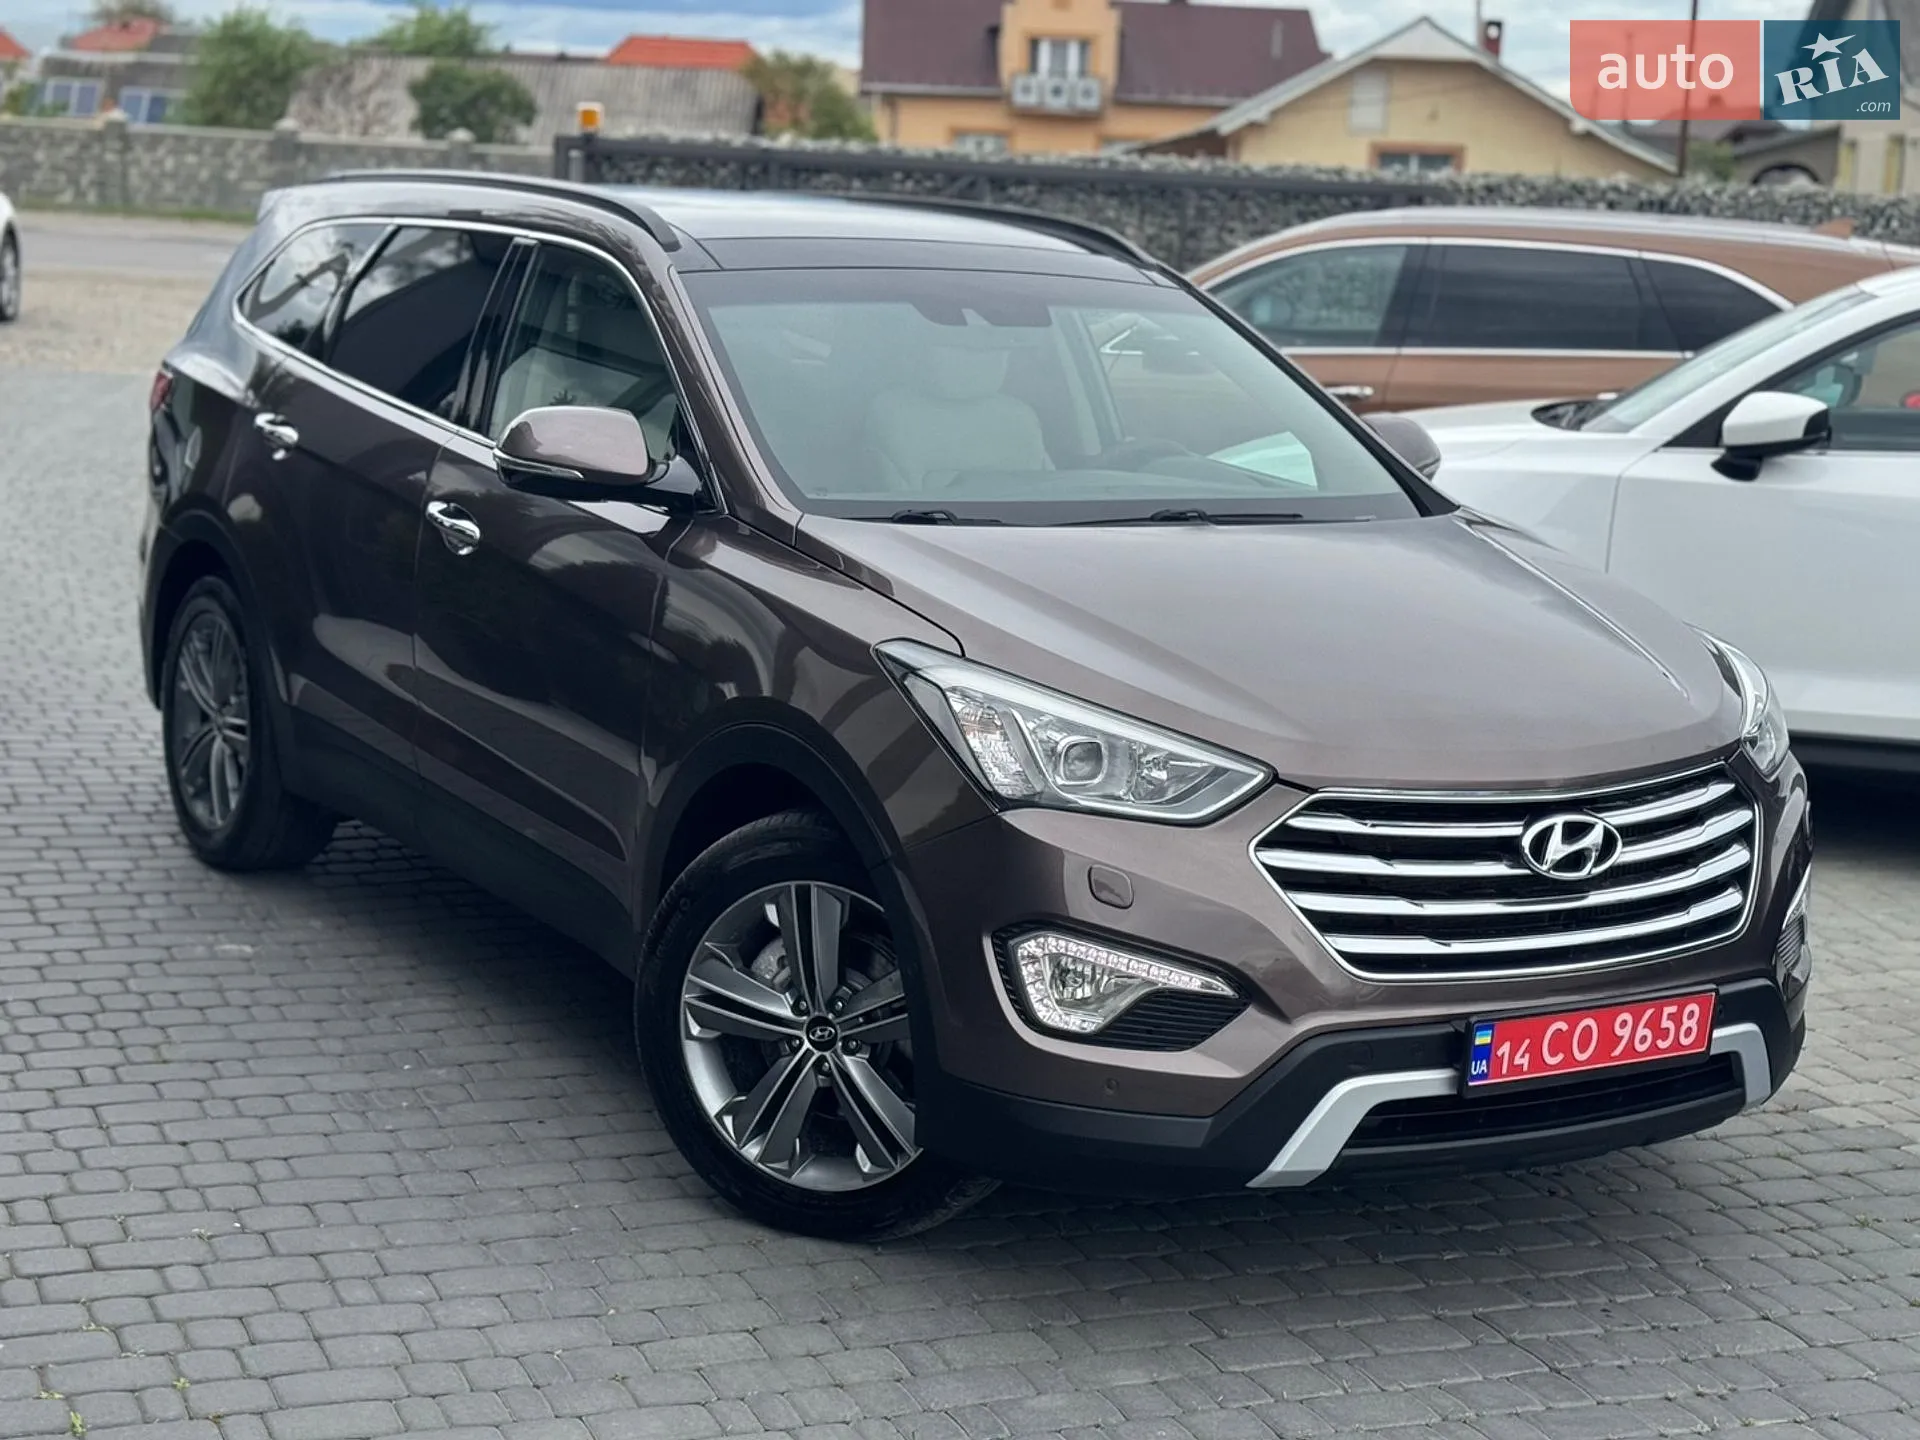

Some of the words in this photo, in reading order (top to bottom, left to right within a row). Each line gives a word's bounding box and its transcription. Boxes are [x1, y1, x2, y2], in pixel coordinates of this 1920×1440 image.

[1496, 1038, 1531, 1075] 14
[1541, 1017, 1599, 1065] CO
[1610, 1002, 1700, 1057] 9658
[1470, 1059, 1488, 1075] UA
